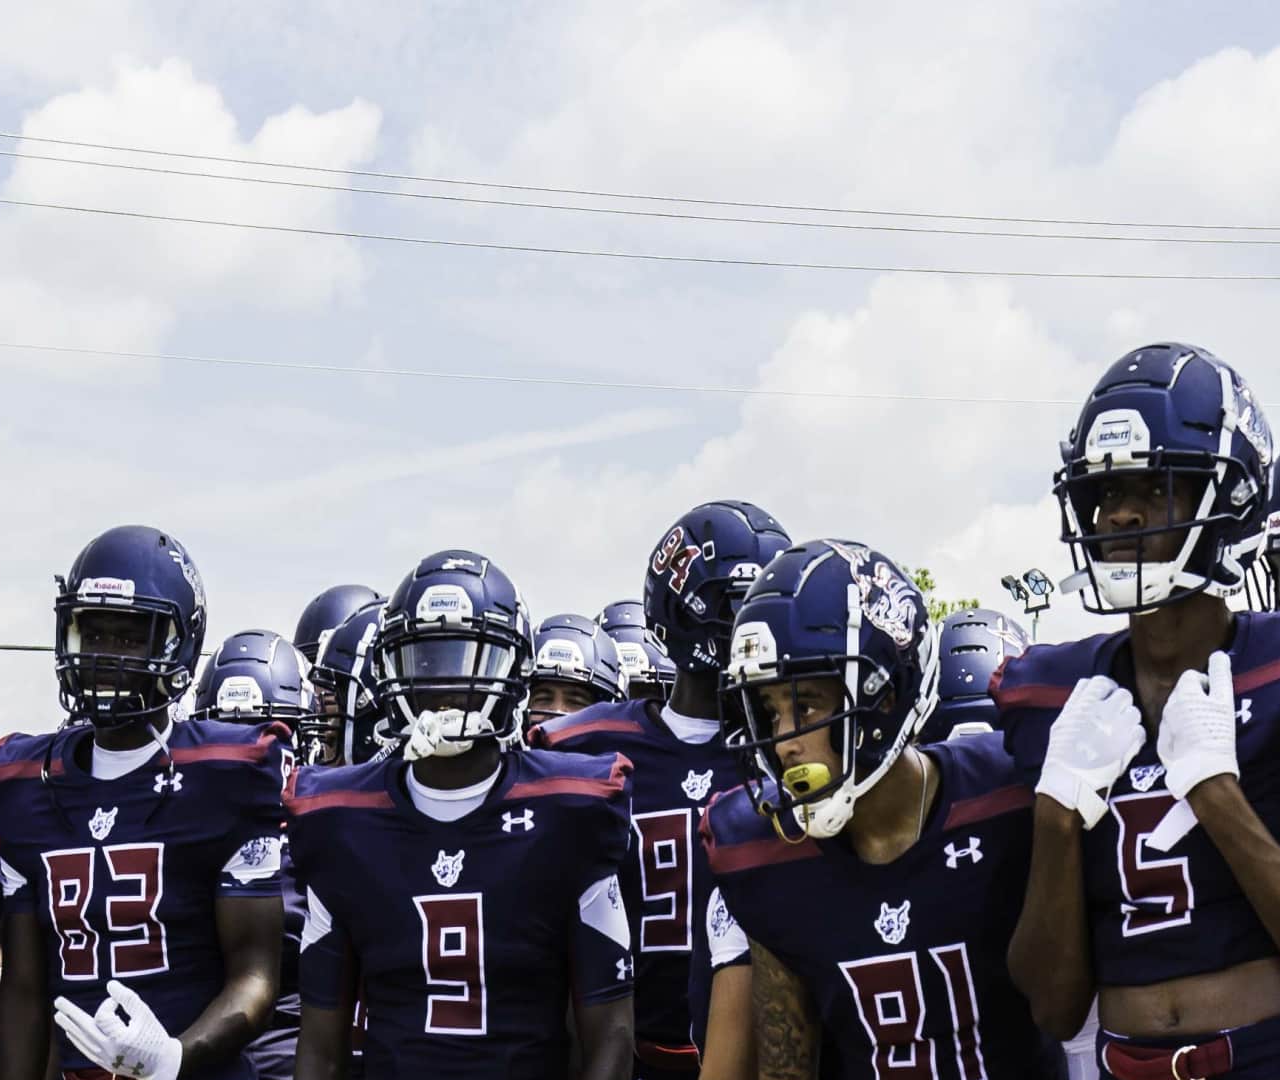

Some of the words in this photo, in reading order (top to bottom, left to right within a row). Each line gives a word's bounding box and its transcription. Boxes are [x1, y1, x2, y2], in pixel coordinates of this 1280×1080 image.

[1099, 430, 1129, 441] schutt
[431, 600, 457, 608] schutt
[652, 526, 702, 595] 94
[40, 842, 170, 981] 83
[1108, 788, 1195, 938] 5
[412, 892, 488, 1036] 9
